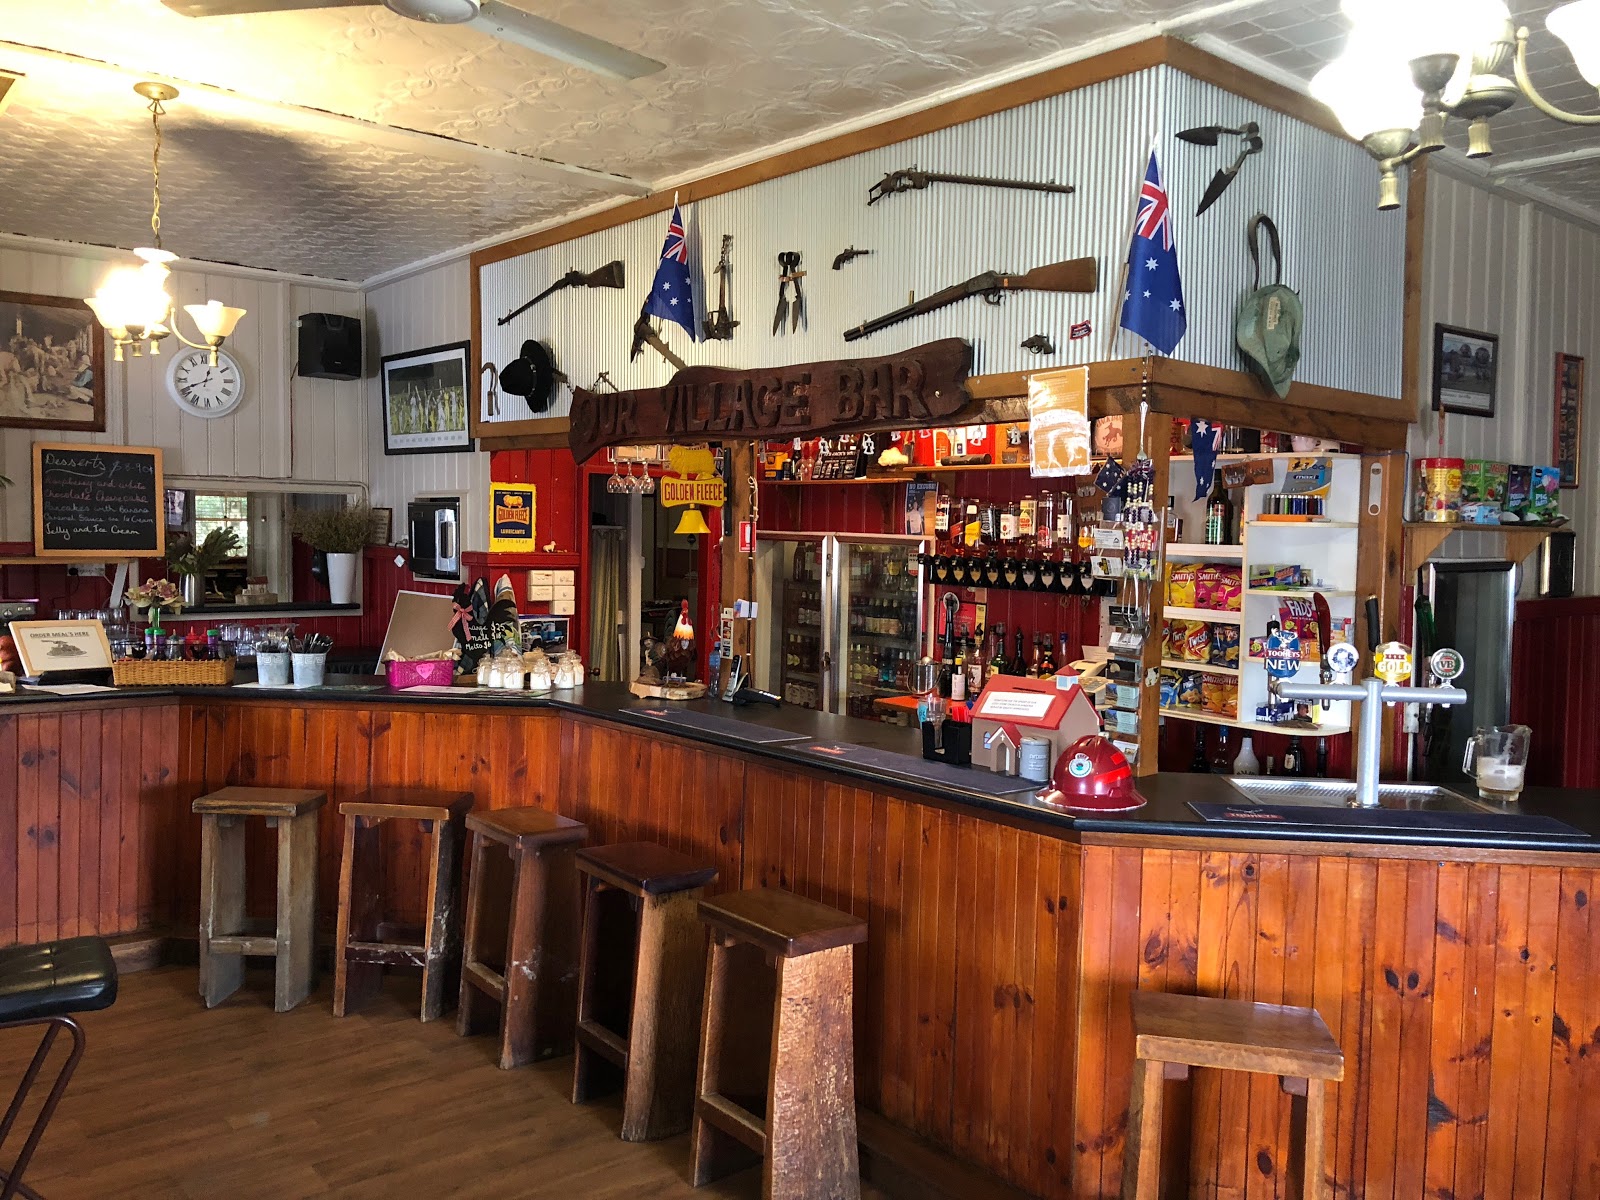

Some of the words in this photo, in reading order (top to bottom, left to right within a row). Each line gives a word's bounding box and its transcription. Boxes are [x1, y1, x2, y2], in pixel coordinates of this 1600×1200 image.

[579, 390, 641, 443] OUR
[660, 371, 813, 435] VILLAGE
[832, 357, 934, 423] BAR
[45, 452, 106, 471] Desserts
[664, 482, 695, 501] GOLDEN
[696, 483, 723, 501] FLEECE
[45, 522, 71, 540] Jelly
[93, 523, 107, 533] Ice
[111, 525, 140, 535] Cream
[1285, 600, 1313, 618] FADS
[1267, 650, 1301, 658] TOOHEYS
[1265, 659, 1300, 671] NEW
[1377, 660, 1412, 673] GOLD
[1440, 660, 1454, 669] VB
